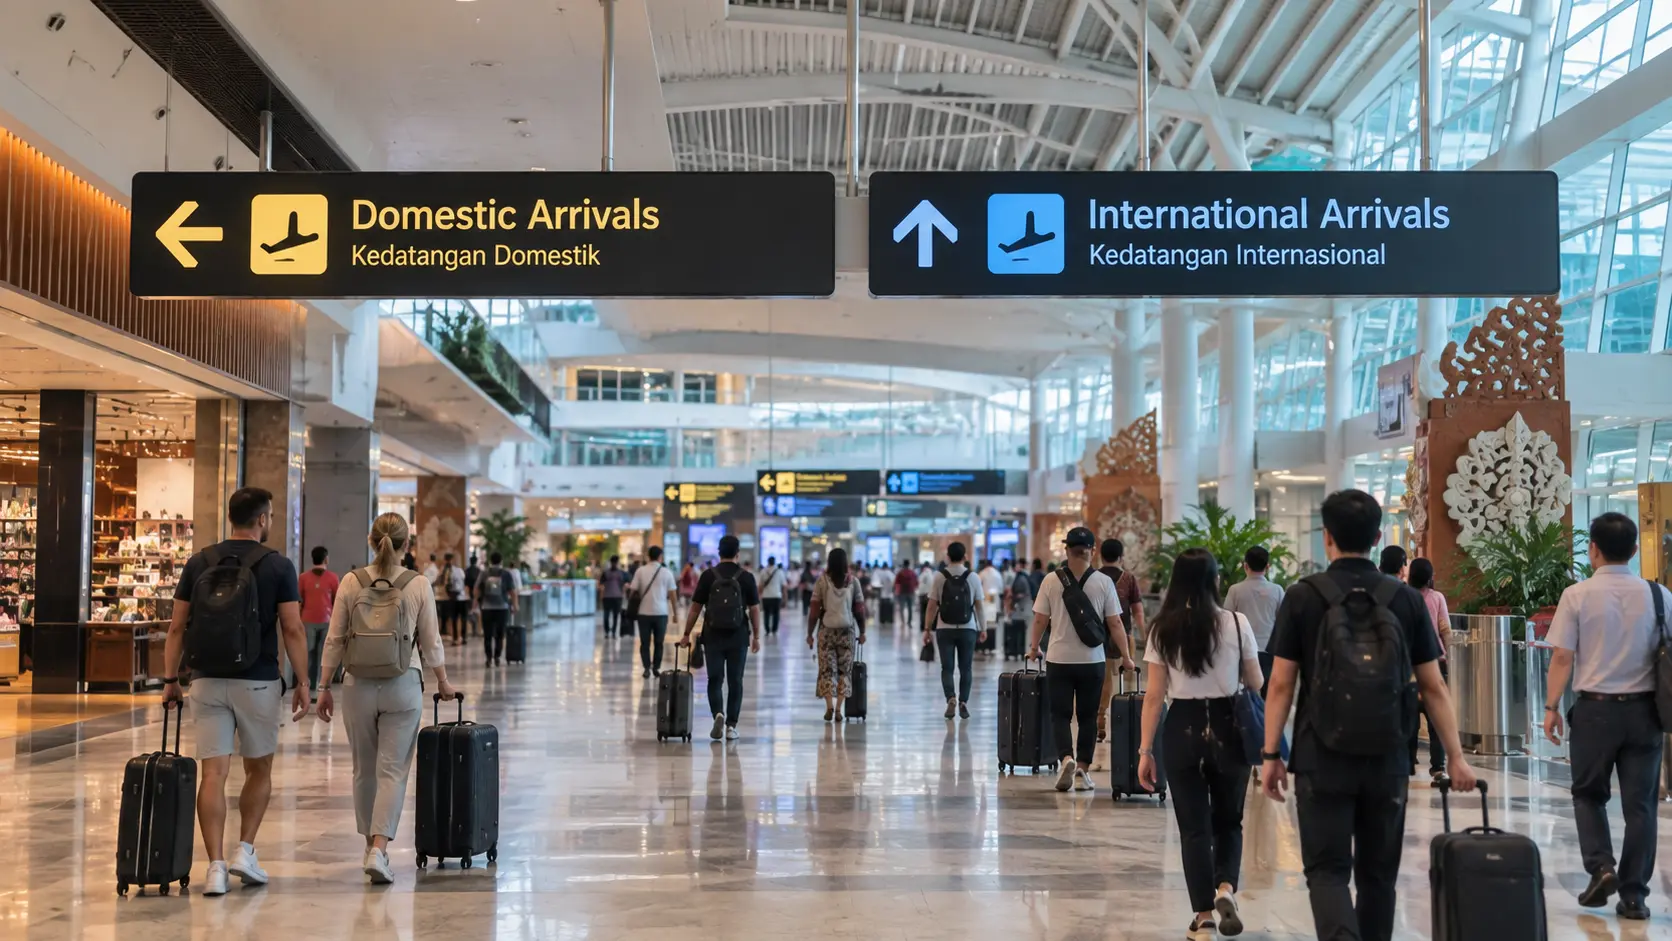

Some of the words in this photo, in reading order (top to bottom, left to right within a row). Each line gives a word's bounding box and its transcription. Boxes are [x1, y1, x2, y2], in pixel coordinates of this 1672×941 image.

[353, 198, 517, 230] Domestic
[528, 198, 660, 230] Arrivals
[1090, 197, 1308, 229] International
[1320, 197, 1451, 229] Arrivals
[353, 244, 486, 271] Kedatangan
[494, 244, 601, 266] Domestik
[1090, 243, 1228, 270] Kedatangan
[1237, 243, 1386, 266] Internasional
